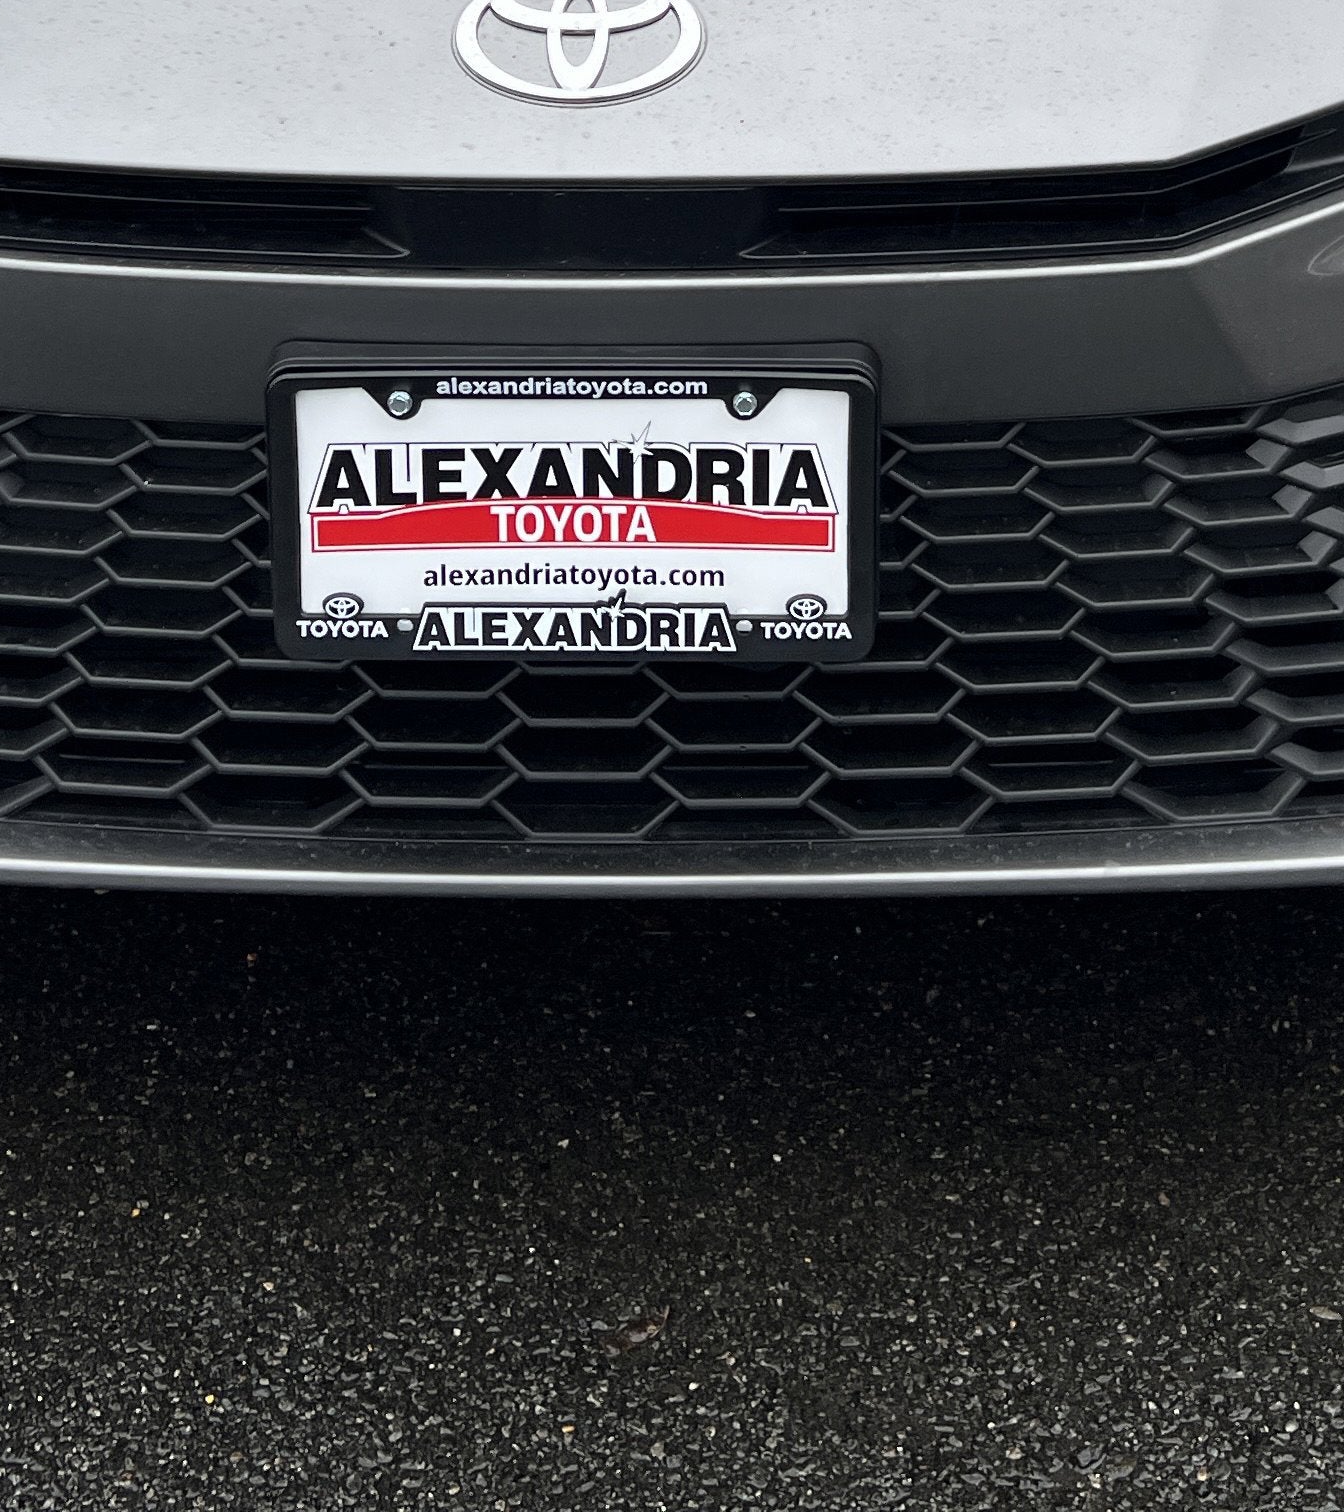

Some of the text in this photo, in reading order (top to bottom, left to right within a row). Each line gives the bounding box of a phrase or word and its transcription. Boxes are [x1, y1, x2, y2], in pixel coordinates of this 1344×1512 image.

[436, 377, 708, 398] alexandriatoyota.com
[311, 444, 835, 510] ALEXANDRIA
[489, 504, 657, 543] TOYOTA
[423, 563, 725, 591] alexandriatoyota.com
[295, 619, 389, 638] TOYOTA
[413, 606, 738, 652] ALEXANDRIA
[760, 621, 853, 639] TOYOTA
